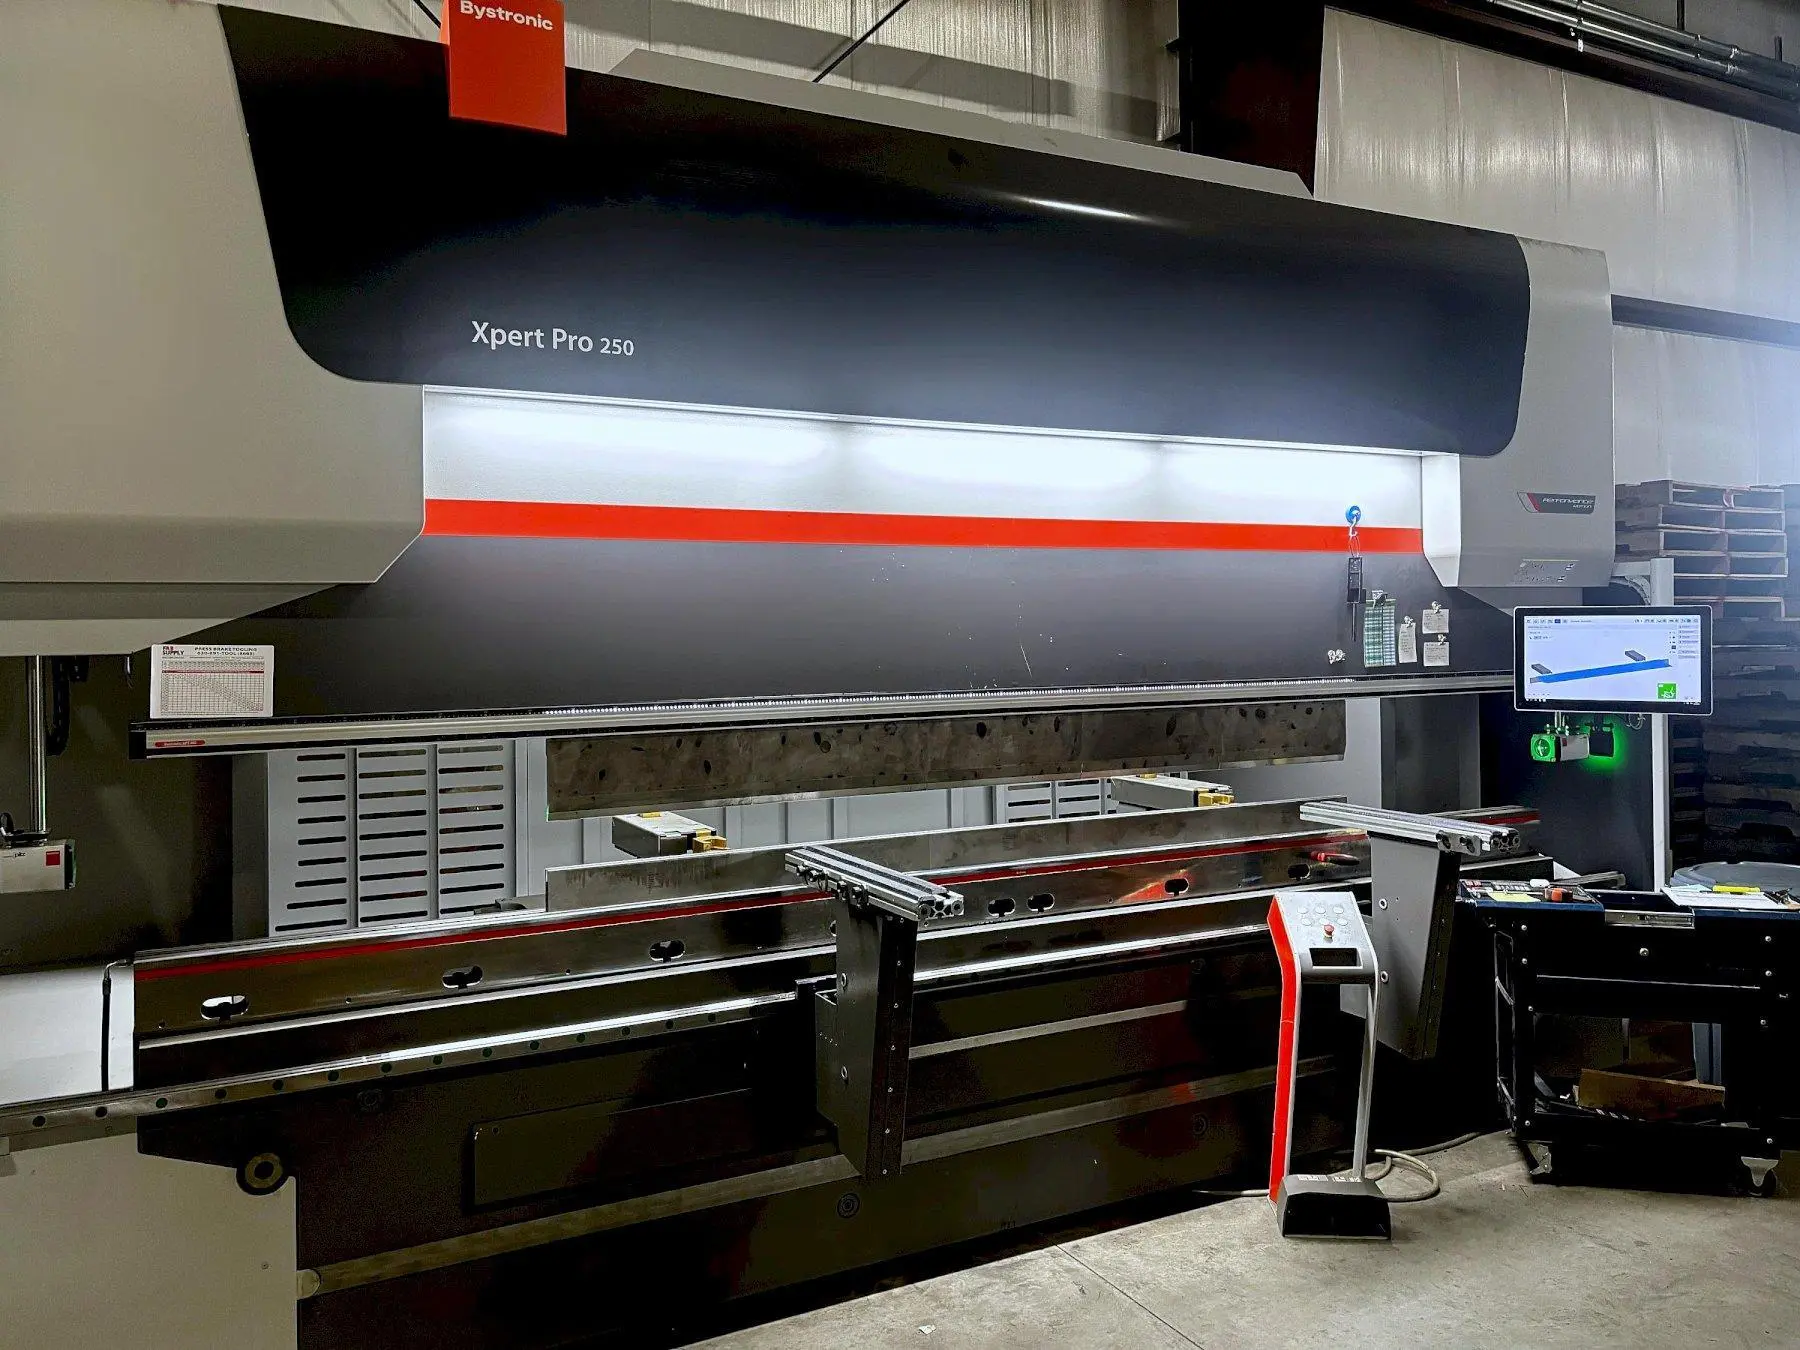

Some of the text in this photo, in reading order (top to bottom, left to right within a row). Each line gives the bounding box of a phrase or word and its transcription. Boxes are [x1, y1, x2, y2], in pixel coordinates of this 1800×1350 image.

[460, 0, 553, 31] Bystronic
[471, 320, 635, 356] Xpert Pro 250
